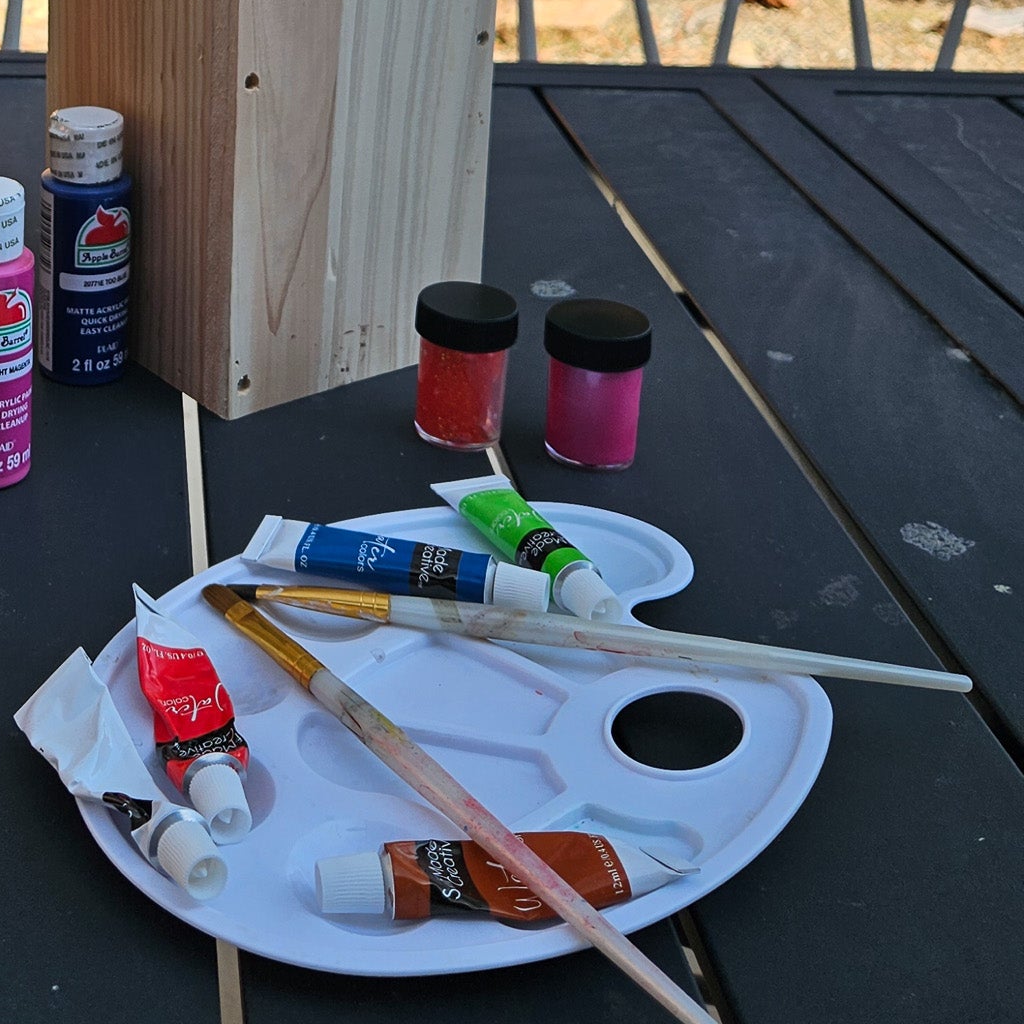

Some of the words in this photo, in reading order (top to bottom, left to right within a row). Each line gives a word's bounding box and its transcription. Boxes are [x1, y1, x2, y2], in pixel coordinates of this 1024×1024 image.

[1, 216, 17, 229] USA
[5, 237, 19, 249] USA
[81, 253, 109, 263] Apple
[66, 307, 95, 315] MATTE
[81, 316, 107, 326] QUICK
[80, 327, 102, 335] EASY
[72, 358, 81, 372] 2
[84, 359, 93, 372] fl
[96, 359, 111, 371] oz
[113, 351, 123, 367] 59
[1, 401, 28, 419] DRYING
[6, 452, 20, 471] 59
[357, 543, 368, 572] colors
[432, 548, 452, 573] ade
[439, 841, 464, 886] Creativ
[608, 869, 624, 894] 12ml
